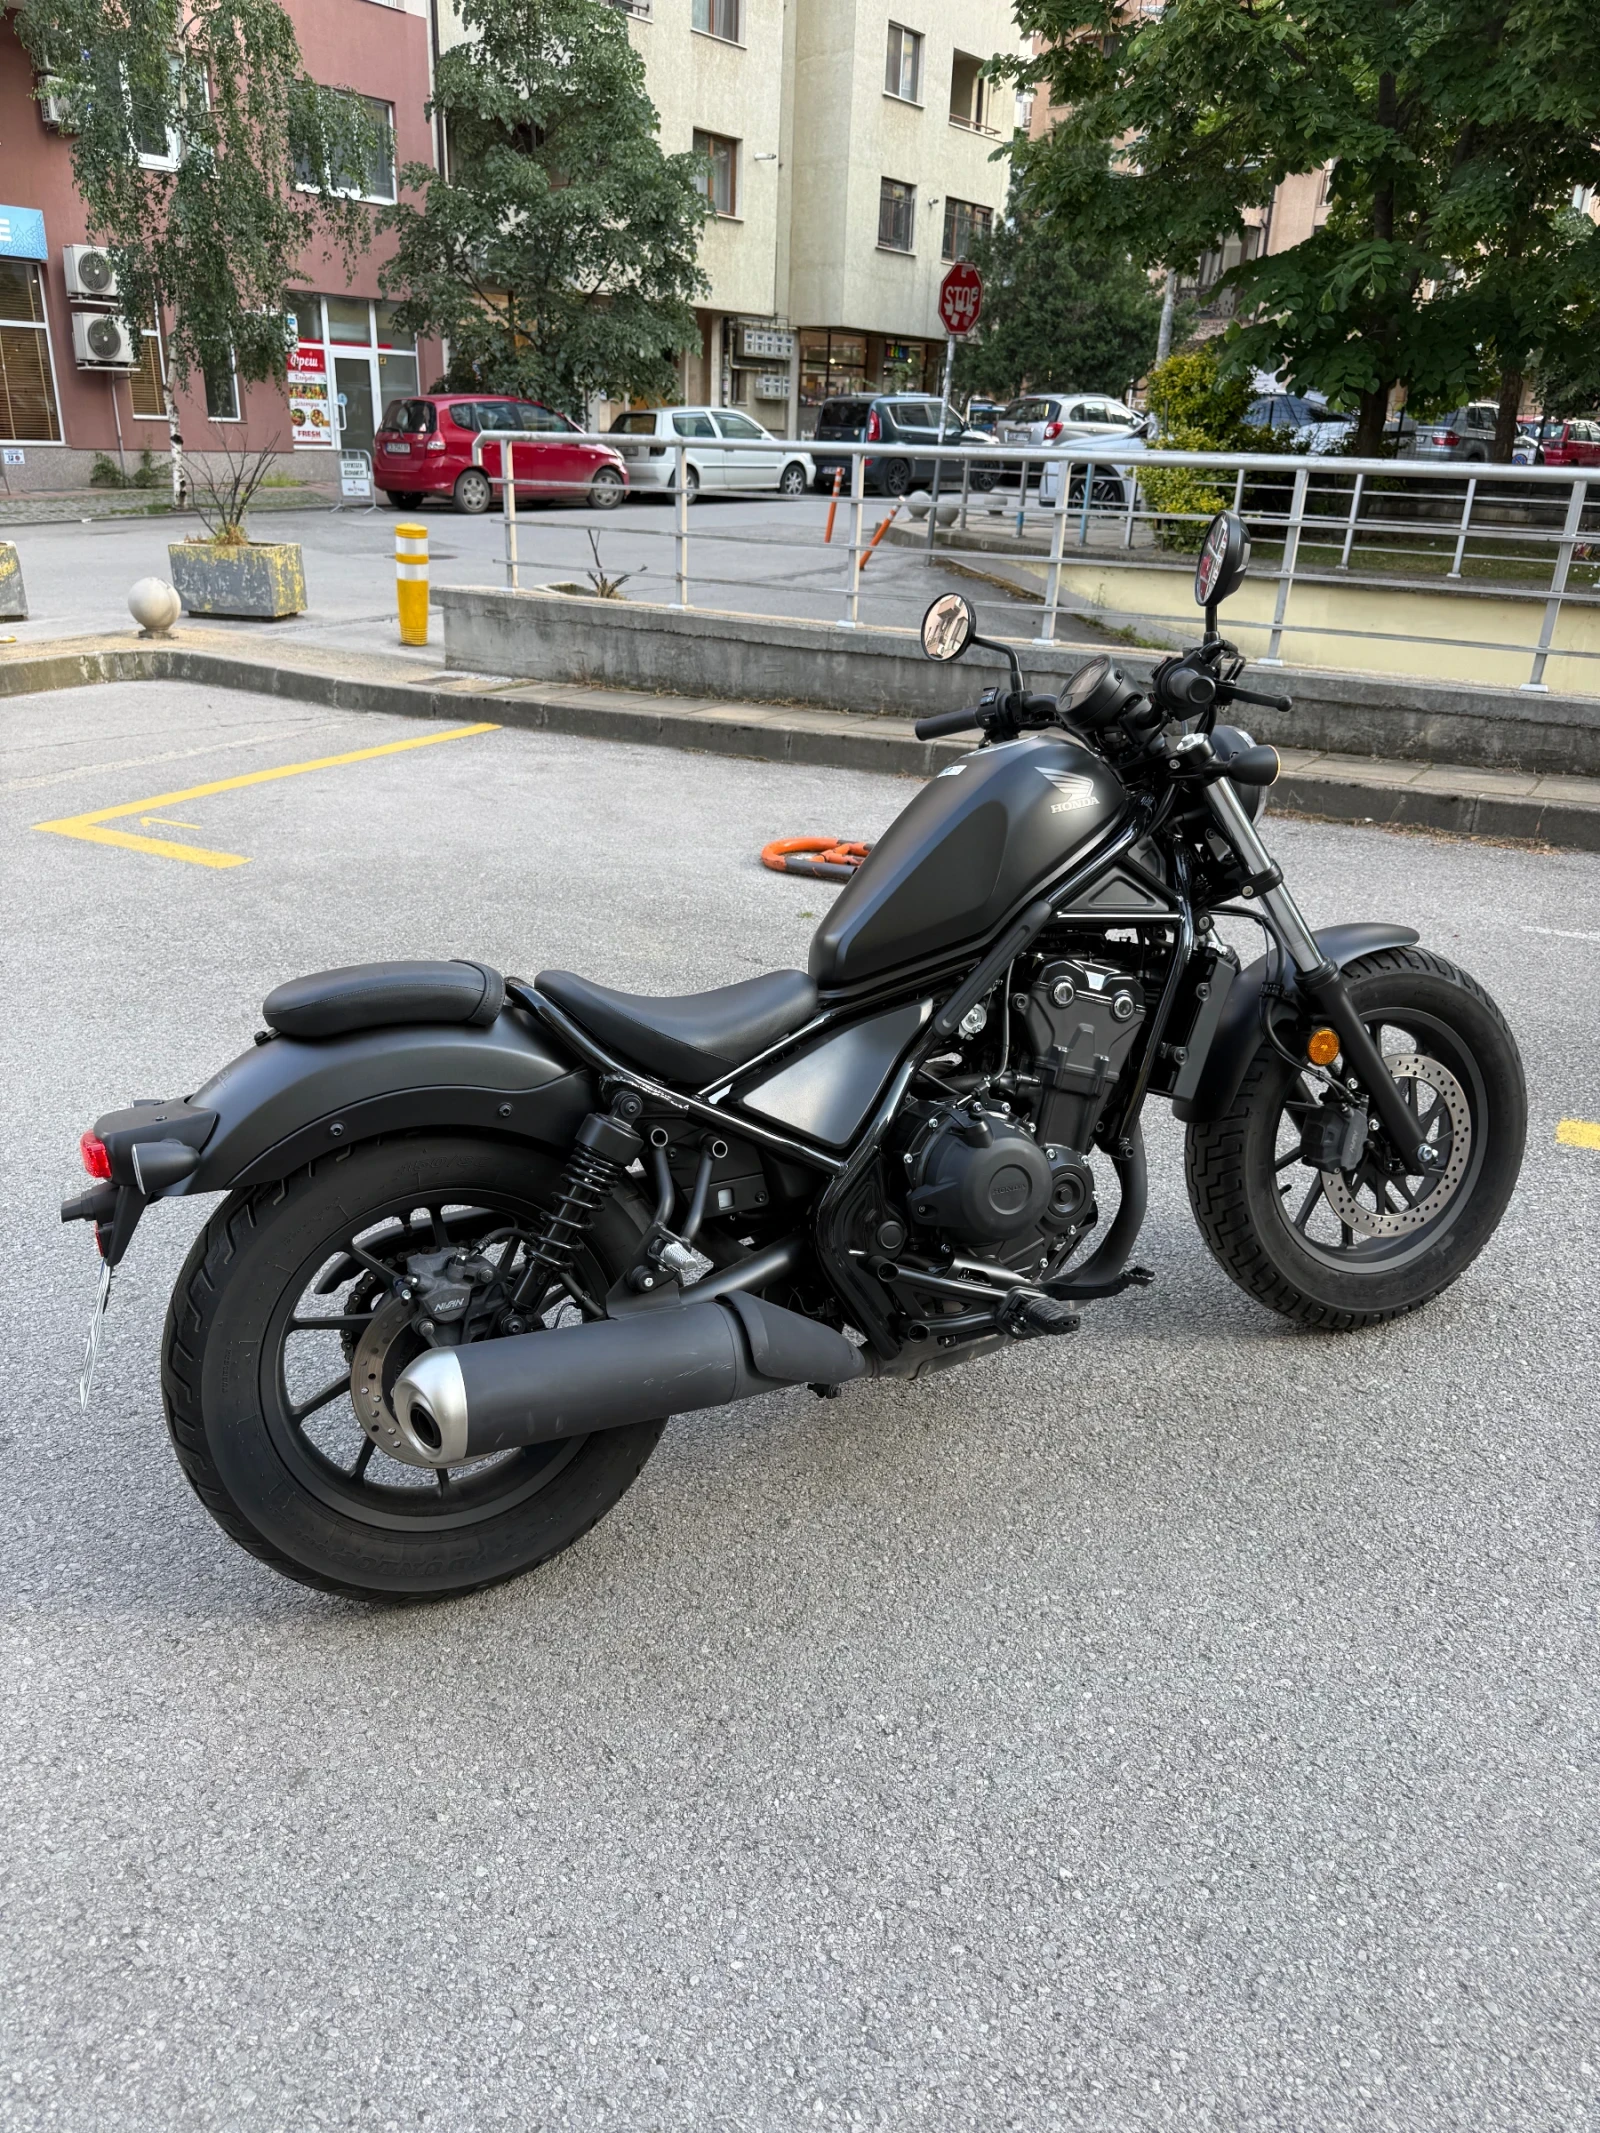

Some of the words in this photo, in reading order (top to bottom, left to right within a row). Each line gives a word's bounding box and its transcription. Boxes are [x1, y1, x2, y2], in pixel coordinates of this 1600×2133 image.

[945, 286, 979, 312] STOP
[290, 353, 319, 371] Фреш
[297, 430, 321, 438] FRESH
[1050, 796, 1100, 814] HONDA
